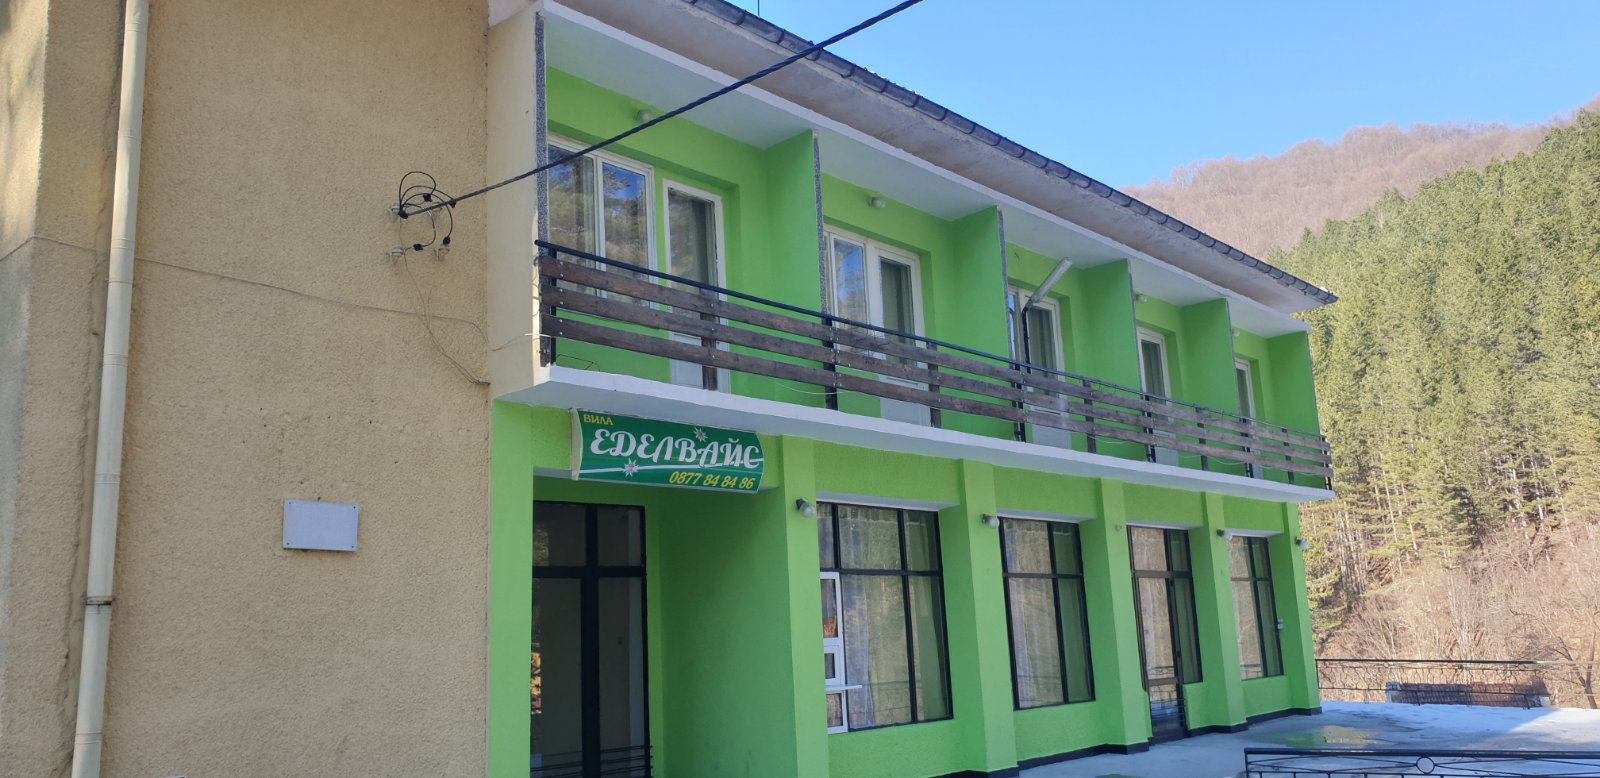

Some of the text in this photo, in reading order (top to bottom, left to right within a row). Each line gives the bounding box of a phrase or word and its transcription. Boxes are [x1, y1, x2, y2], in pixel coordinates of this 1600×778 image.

[583, 414, 614, 426] ВИЛА
[590, 428, 760, 468] ЕДЕЛВАЙС
[669, 471, 756, 489] 0877 84 84 86
